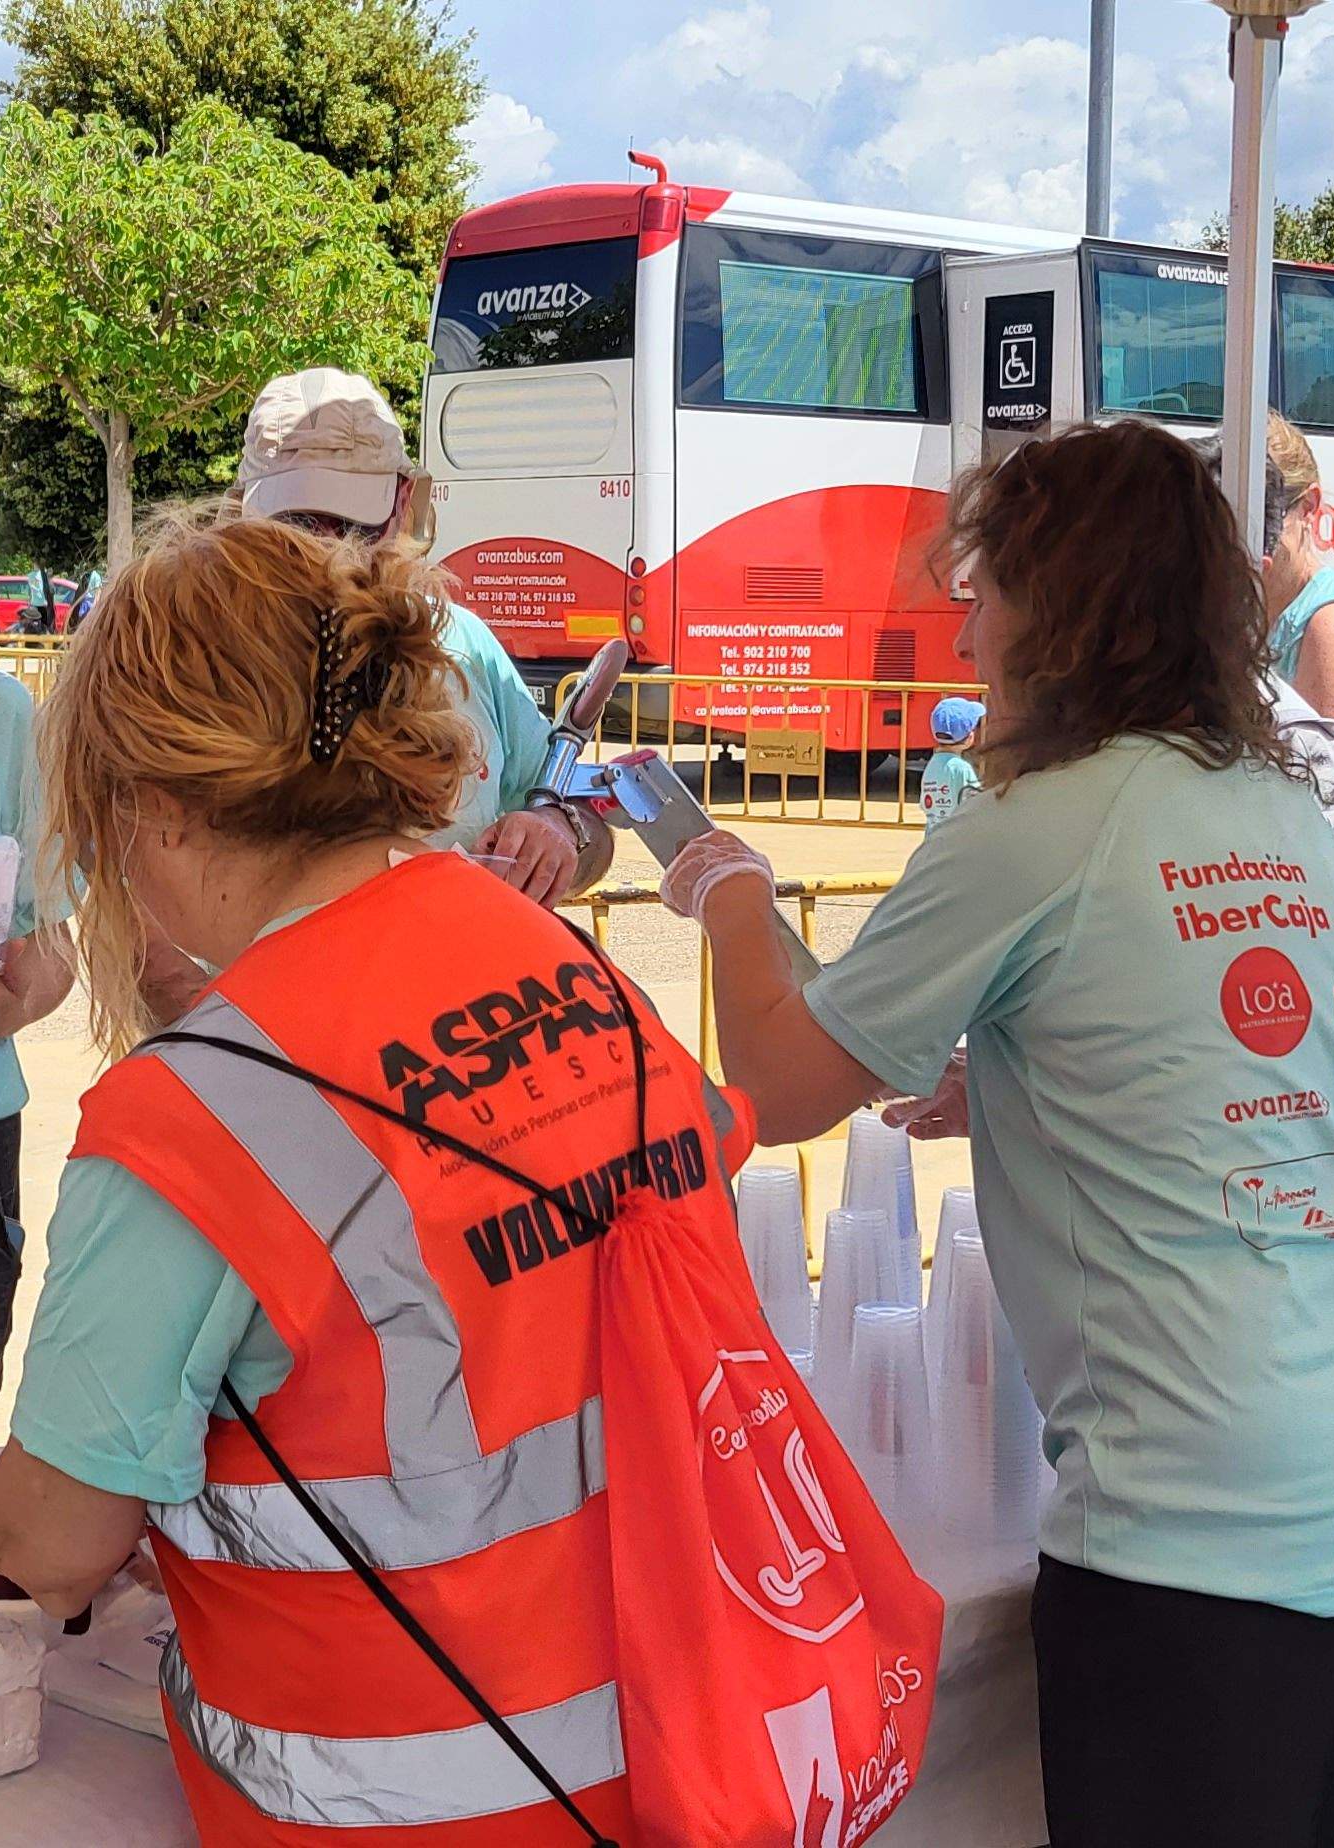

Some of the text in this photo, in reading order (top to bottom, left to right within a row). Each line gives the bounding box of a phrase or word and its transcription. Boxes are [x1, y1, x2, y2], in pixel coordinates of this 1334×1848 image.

[477, 282, 568, 316] avanza
[1002, 323, 1033, 336] ACCESO
[987, 403, 1035, 418] avanza
[431, 485, 449, 501] 410
[600, 480, 630, 498] 8410
[477, 547, 564, 564] avanzabus.com
[687, 623, 844, 637] INFORMACIÓN Y CONTRATACIÓN
[721, 646, 811, 658] Tel. 902 210 700
[720, 663, 810, 675] Tel. 974 218 352
[1159, 851, 1307, 892] Fundación
[1173, 894, 1330, 942] iberCaja
[1223, 1090, 1323, 1124] avanza
[511, 1124, 529, 1141] de
